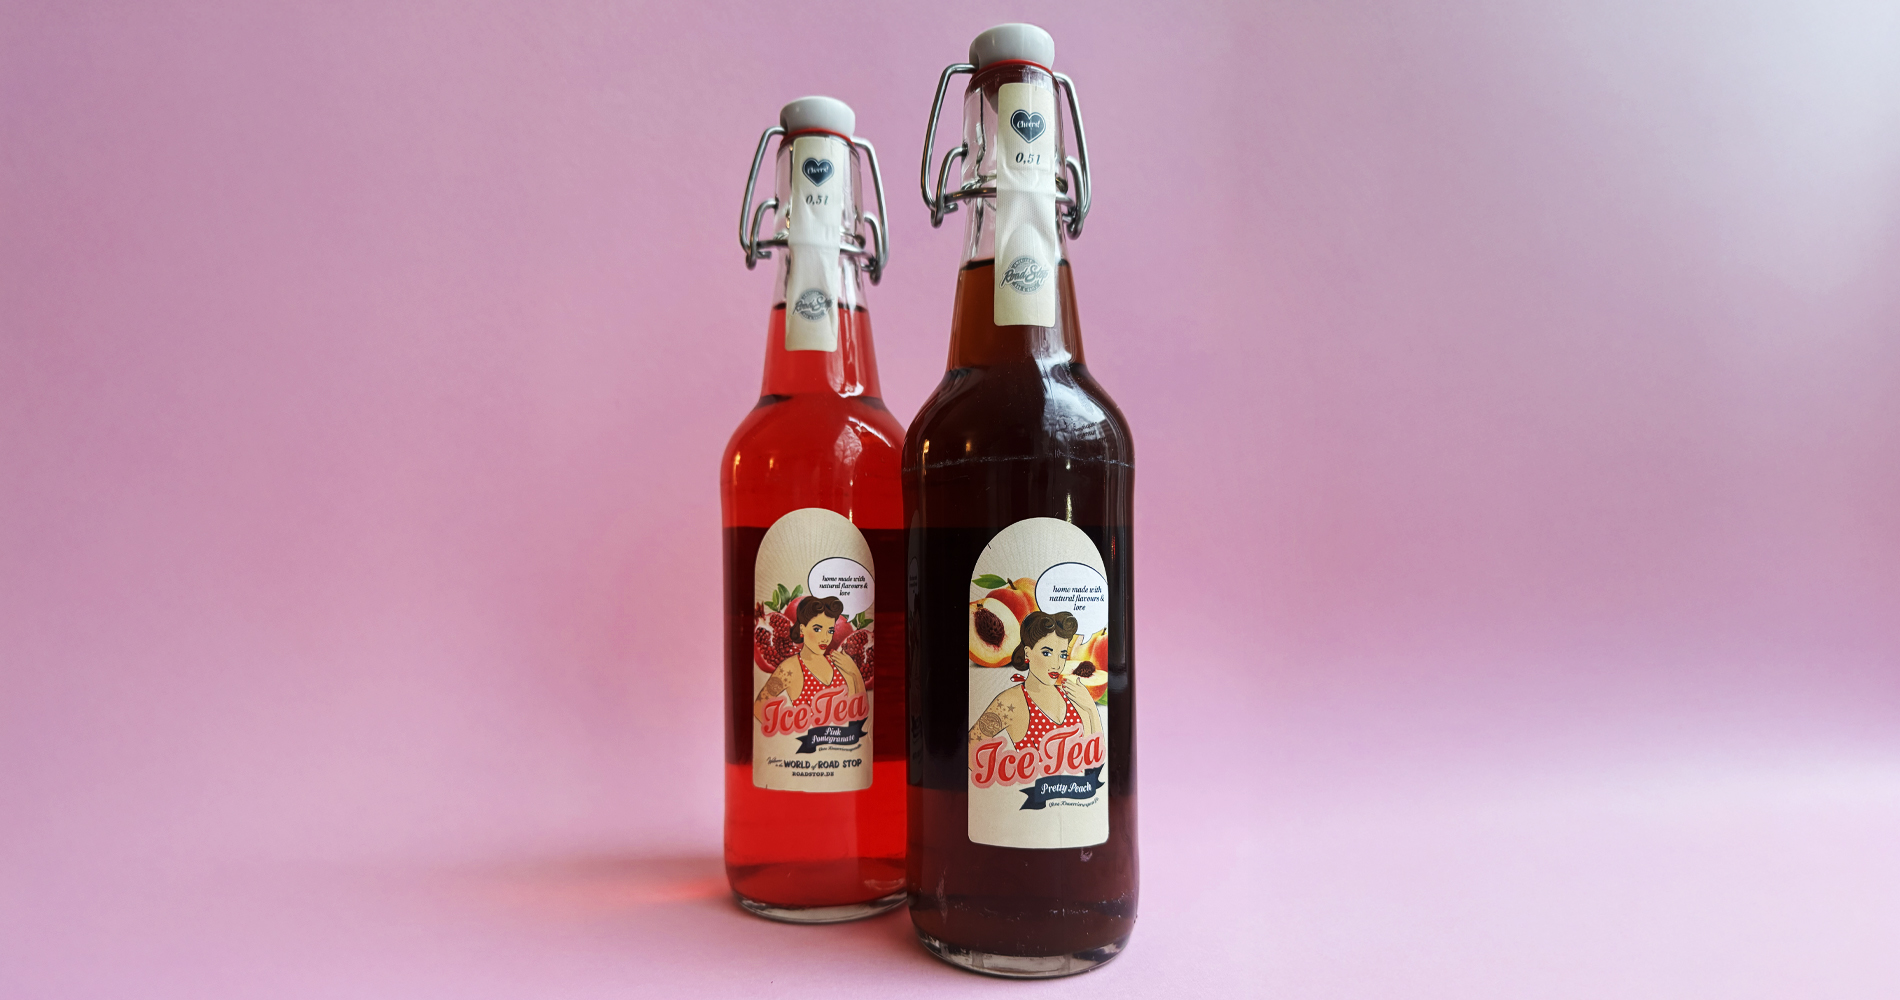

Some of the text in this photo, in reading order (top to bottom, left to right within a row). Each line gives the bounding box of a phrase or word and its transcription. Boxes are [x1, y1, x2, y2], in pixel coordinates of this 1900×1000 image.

[1016, 120, 1041, 129] Cheers!
[1052, 585, 1102, 593] home made with
[1049, 594, 1075, 602] natural
[1074, 594, 1100, 603] flavours
[1073, 603, 1086, 611] love
[763, 688, 867, 734] Ice Tea
[823, 727, 842, 736] Pink
[975, 727, 1103, 784] Ice Tea
[783, 760, 810, 769] WORLD
[817, 760, 840, 769] ROAD
[842, 758, 862, 768] STOP
[1041, 782, 1092, 795] Pretty Peach
